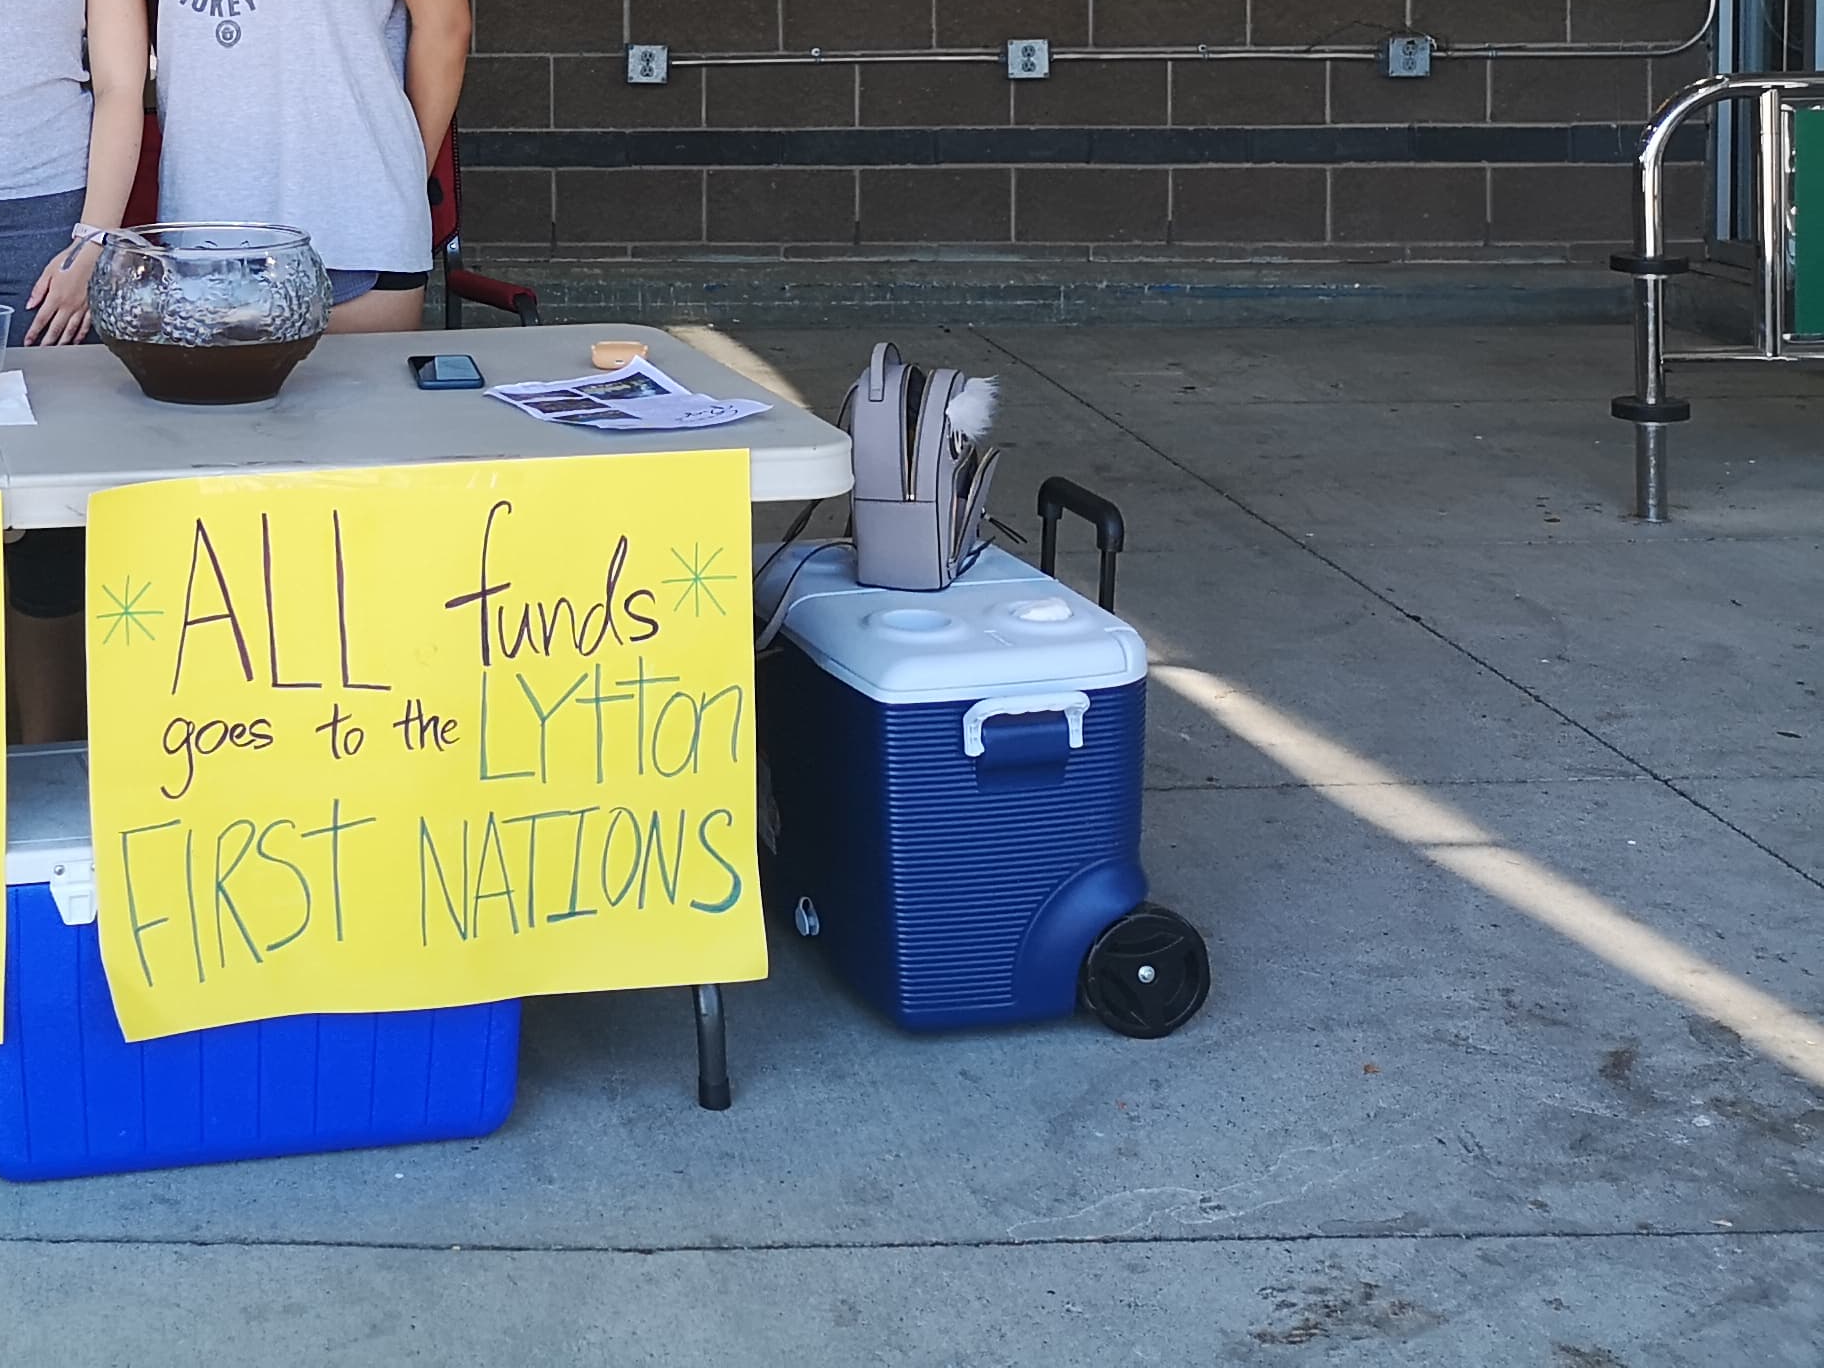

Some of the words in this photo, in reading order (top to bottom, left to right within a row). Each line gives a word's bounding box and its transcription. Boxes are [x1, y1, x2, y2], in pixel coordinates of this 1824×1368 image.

[172, 506, 393, 695] ALL
[444, 500, 661, 667] funds
[160, 716, 275, 800] goes
[316, 703, 365, 760] to
[392, 698, 461, 752] the
[420, 806, 743, 947] NATIONS
